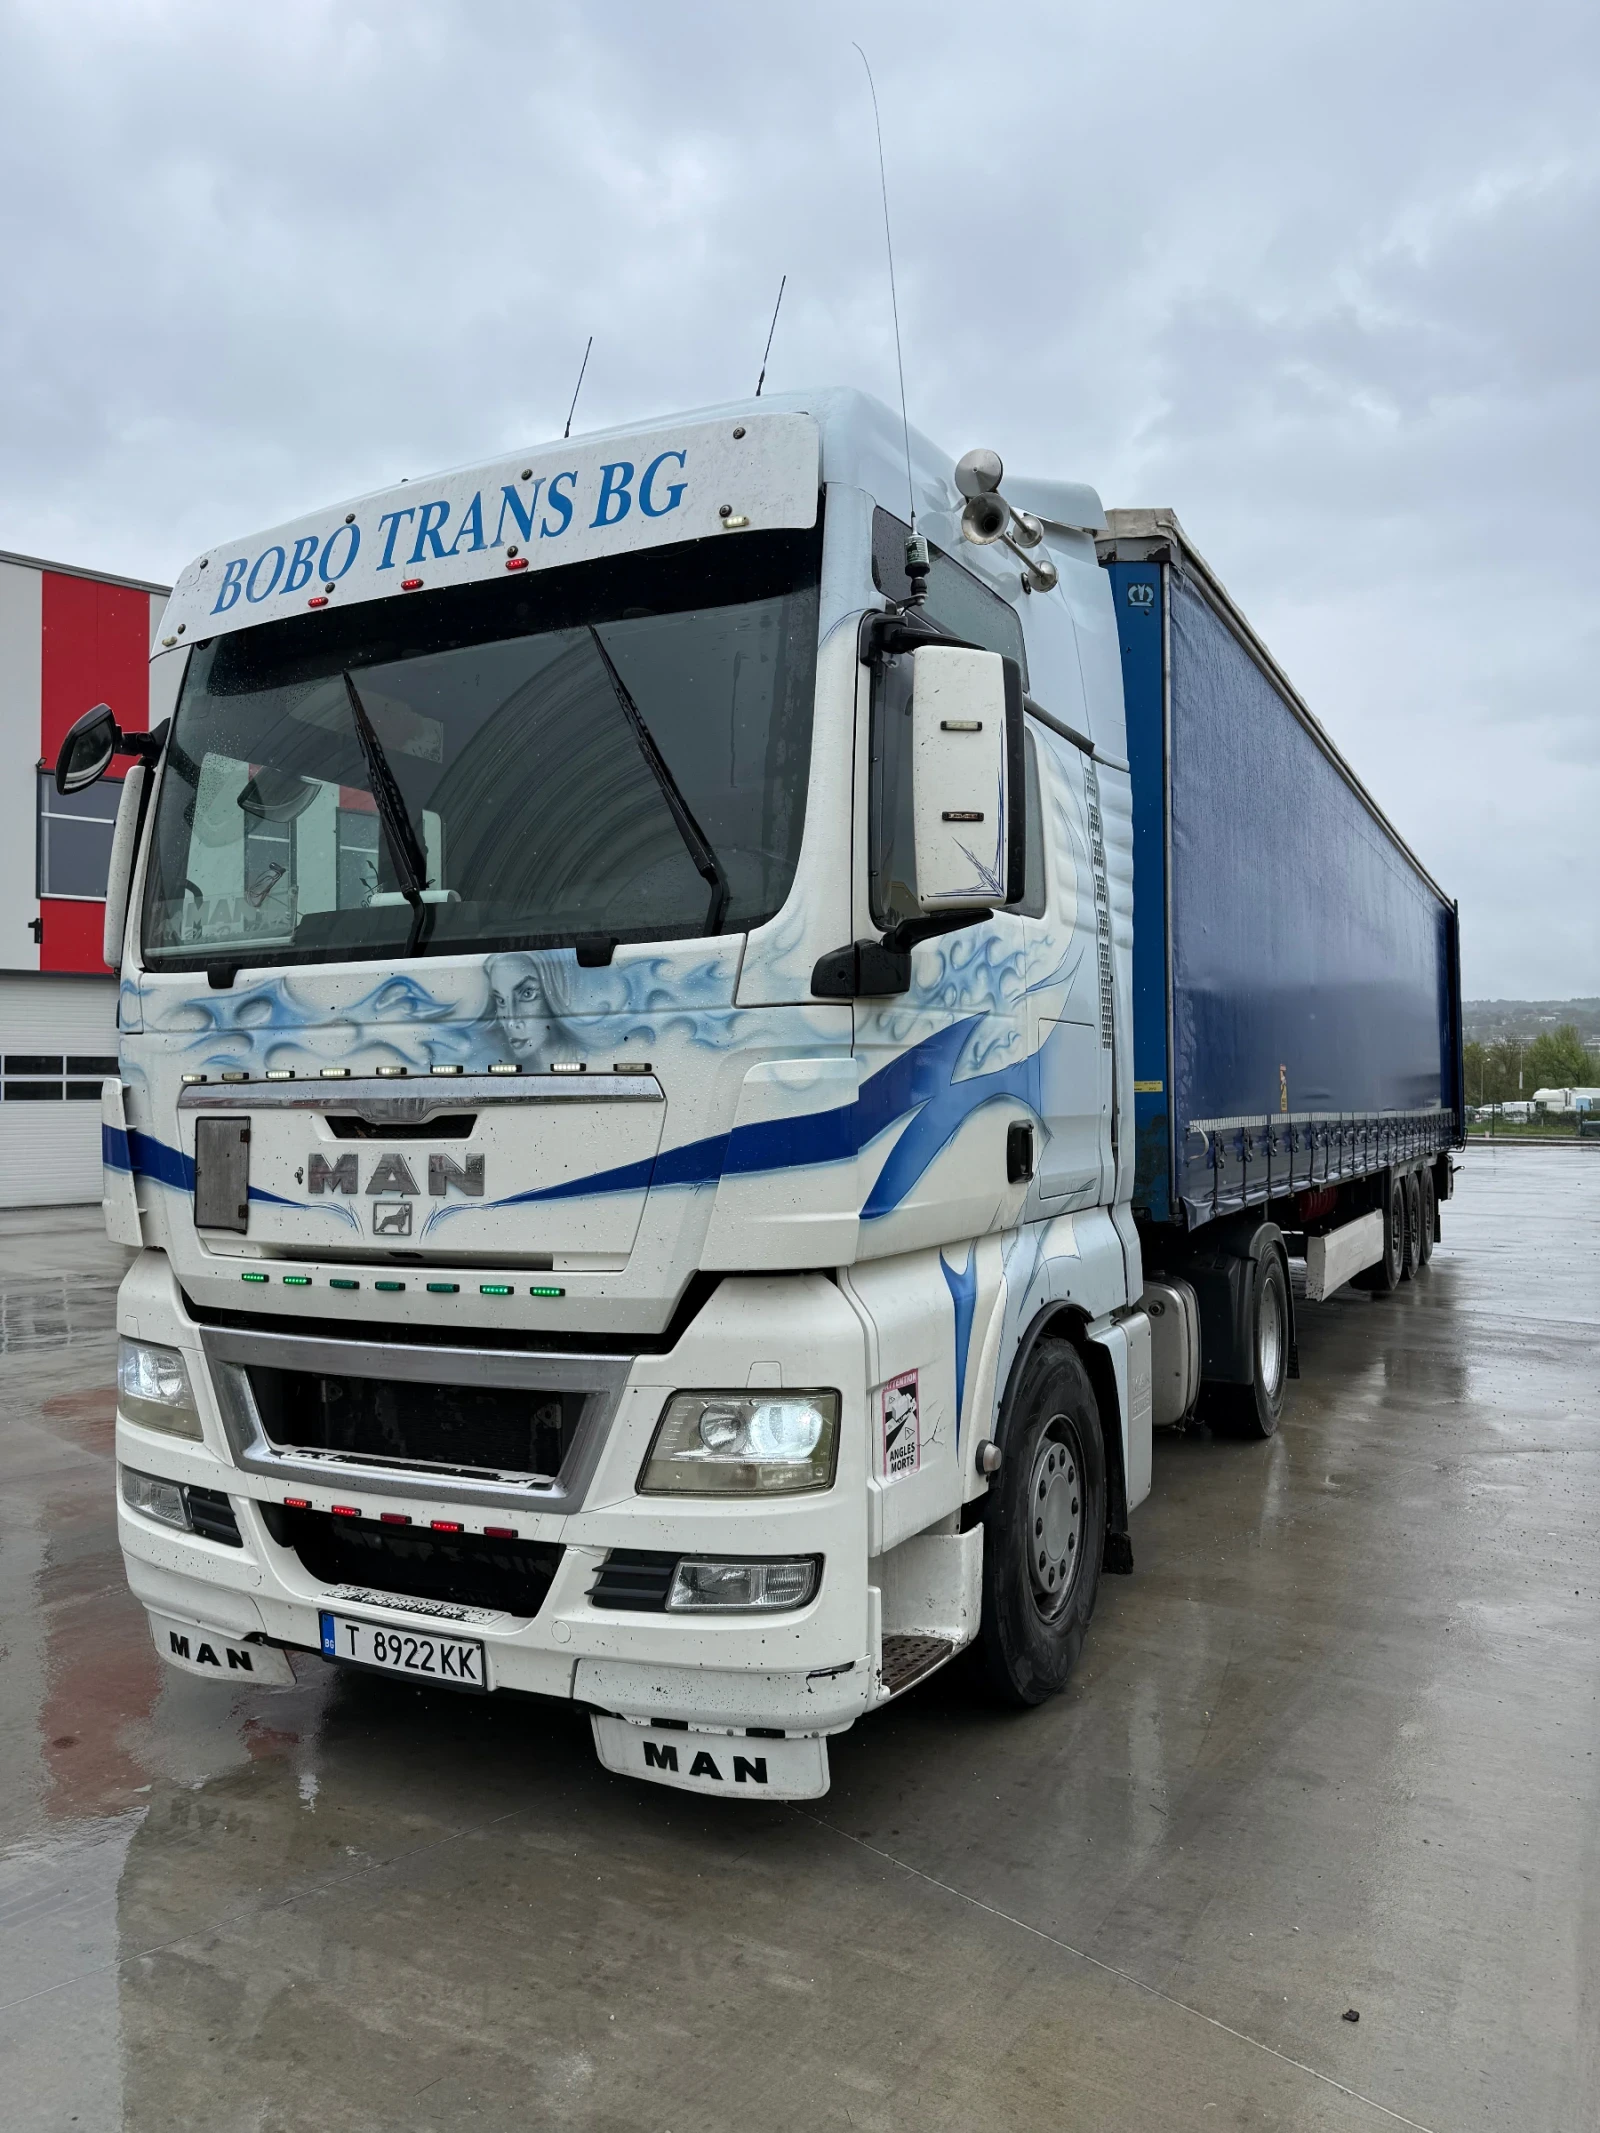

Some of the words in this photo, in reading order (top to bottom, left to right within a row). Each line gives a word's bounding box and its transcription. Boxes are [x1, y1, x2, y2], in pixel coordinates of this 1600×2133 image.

[209, 522, 361, 615] BOBO
[376, 470, 577, 572] TRANS
[588, 448, 689, 529] BG
[307, 1152, 486, 1196] MAN
[890, 1442, 916, 1462] ANGLES
[890, 1454, 915, 1474] MORTS
[169, 1631, 254, 1671] MAN
[324, 1638, 335, 1650] BG
[643, 1741, 769, 1784] MAN
